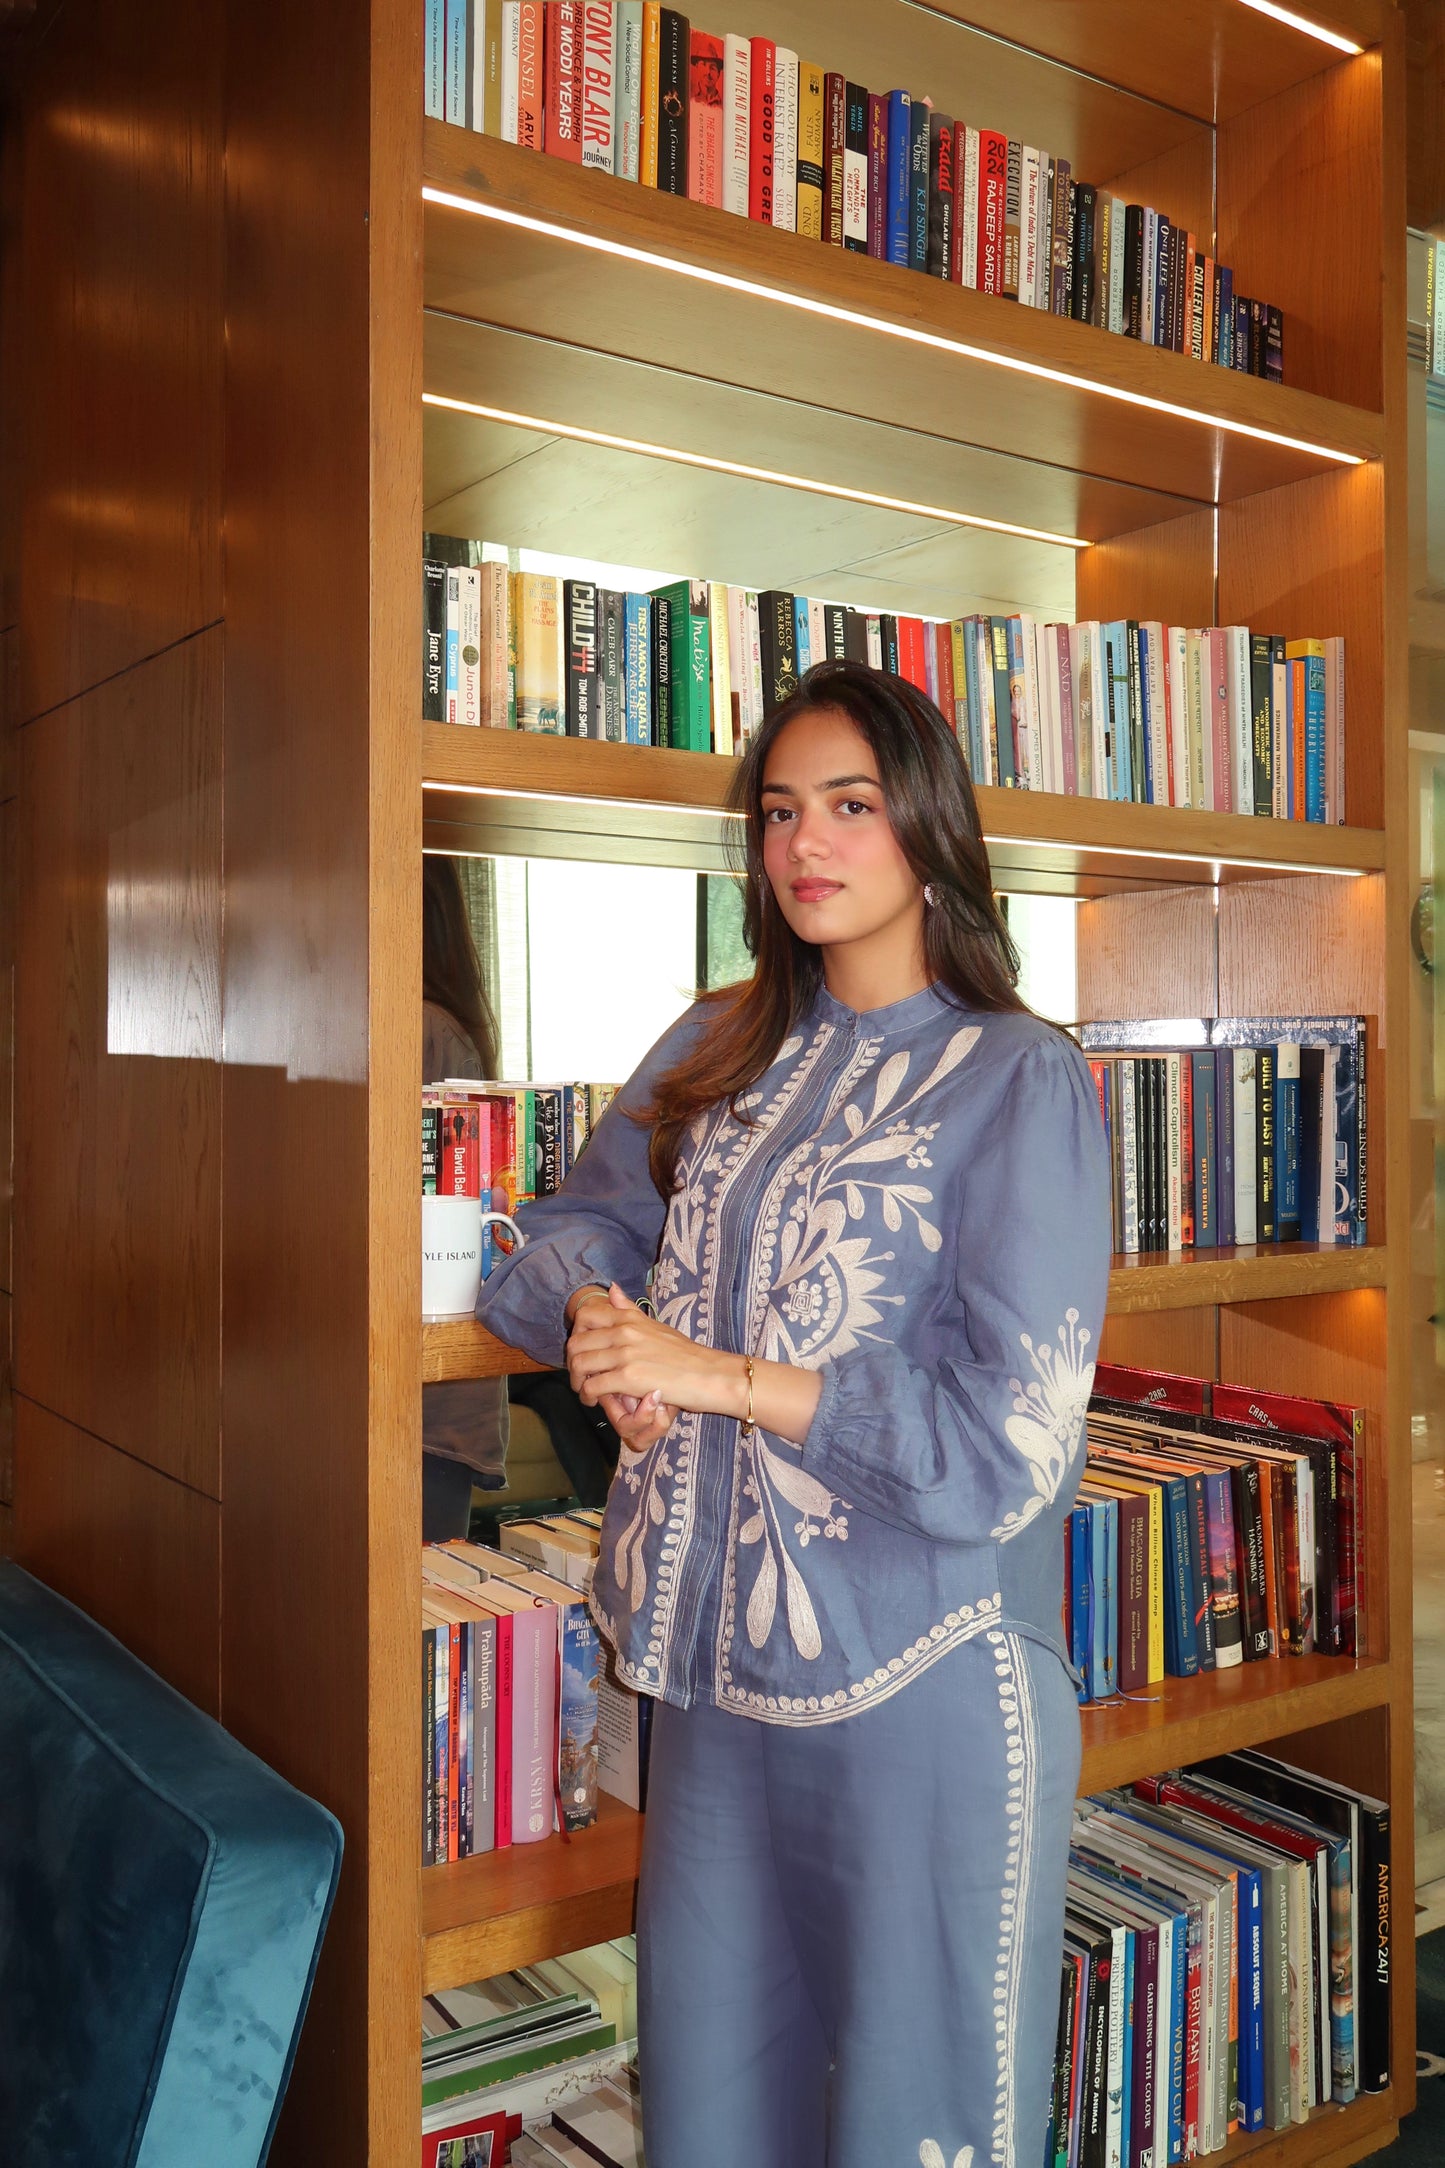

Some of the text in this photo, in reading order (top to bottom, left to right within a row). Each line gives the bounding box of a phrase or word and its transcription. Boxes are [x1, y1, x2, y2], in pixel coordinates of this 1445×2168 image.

[511, 16, 519, 58] SERVANT
[521, 5, 536, 101] COUNSEL
[671, 18, 679, 85] SECULARISM
[559, 25, 573, 139] MODI YEARS
[584, 2, 612, 148] TONY BLAIR
[628, 23, 641, 179] What We Owe Each Other
[734, 50, 748, 161] MY FRIEND MICHAEL
[775, 62, 786, 128] INTEREST
[573, 87, 582, 143] TRIUMPH
[787, 62, 796, 179] WHO MOVED MY
[814, 109, 822, 159] NARIMAN
[583, 151, 612, 169] JOURNEY
[705, 116, 715, 190] THE BHAGAT SINGH
[761, 93, 773, 223] GOOD TO GRE
[913, 144, 922, 172] ODDS
[921, 123, 930, 174] WHATEVER
[938, 127, 954, 194] azaad
[987, 160, 1005, 176] 24
[988, 142, 1005, 159] 20
[1006, 141, 1021, 217] EXECUTION
[830, 153, 843, 241] SIGMA REVOLUTION
[916, 187, 926, 261] K.P. SINGH
[985, 179, 996, 242] RAJDEEP
[1026, 169, 1038, 284] The Future India's Debt Market
[1056, 188, 1064, 228] RAISINA
[1065, 246, 1073, 291] MASTER
[1079, 213, 1087, 263] MUHAMMAD
[1191, 265, 1204, 361] COLLEEN HOOVER
[659, 600, 669, 685] MICHAEL CRICHTON
[692, 620, 708, 683] Matisse
[777, 601, 786, 647] YARROS
[783, 598, 792, 651] REBECCA
[833, 612, 844, 644] NINTH
[427, 630, 442, 695] Jane Eyre
[450, 643, 458, 677] Cyprus
[466, 667, 476, 706] Junot
[608, 651, 616, 678] CARR
[637, 606, 647, 739] FIRST AMONG EQUALS
[578, 678, 588, 738] TOM ROB SMITH
[605, 686, 614, 737] DARKNESS
[629, 669, 638, 720] ARCHER
[1308, 710, 1317, 755] THEORY
[1033, 753, 1041, 785] BOWEN
[1183, 1066, 1191, 1085] THE
[1262, 1056, 1273, 1147] BUILT TO LAST
[1171, 1061, 1179, 1168] Climate Capitalism
[454, 1147, 466, 1175] David
[545, 1124, 555, 1190] BAD GUYS
[446, 1250, 476, 1261] ISLAND
[1247, 1404, 1269, 1425] CARS
[1329, 1452, 1337, 1500] UNIVERSE
[1135, 1517, 1144, 1599] BHAGAVAD GITA
[1195, 1499, 1208, 1577] PLATFORM SCALE
[1248, 1528, 1258, 1584] HANNIBAL
[1255, 1514, 1267, 1596] THOMAS HARRIS
[478, 1630, 493, 1710] Prabhupāda
[1201, 1792, 1247, 1813] BLITZ
[1279, 1884, 1288, 1939] AMERICA
[1252, 1925, 1260, 1969] ABSOLUT
[1280, 1960, 1289, 1996] HOME
[1109, 1956, 1120, 2065] PRINTED POTTERY
[1301, 1963, 1310, 2030] LEONARDO
[1090, 2005, 1105, 2135] ENCYCLOPEDIA OF ANIMALS
[1144, 1982, 1155, 2129] GARDENING WITH COLOUR
[1171, 2024, 1183, 2127] WORLD CUP
